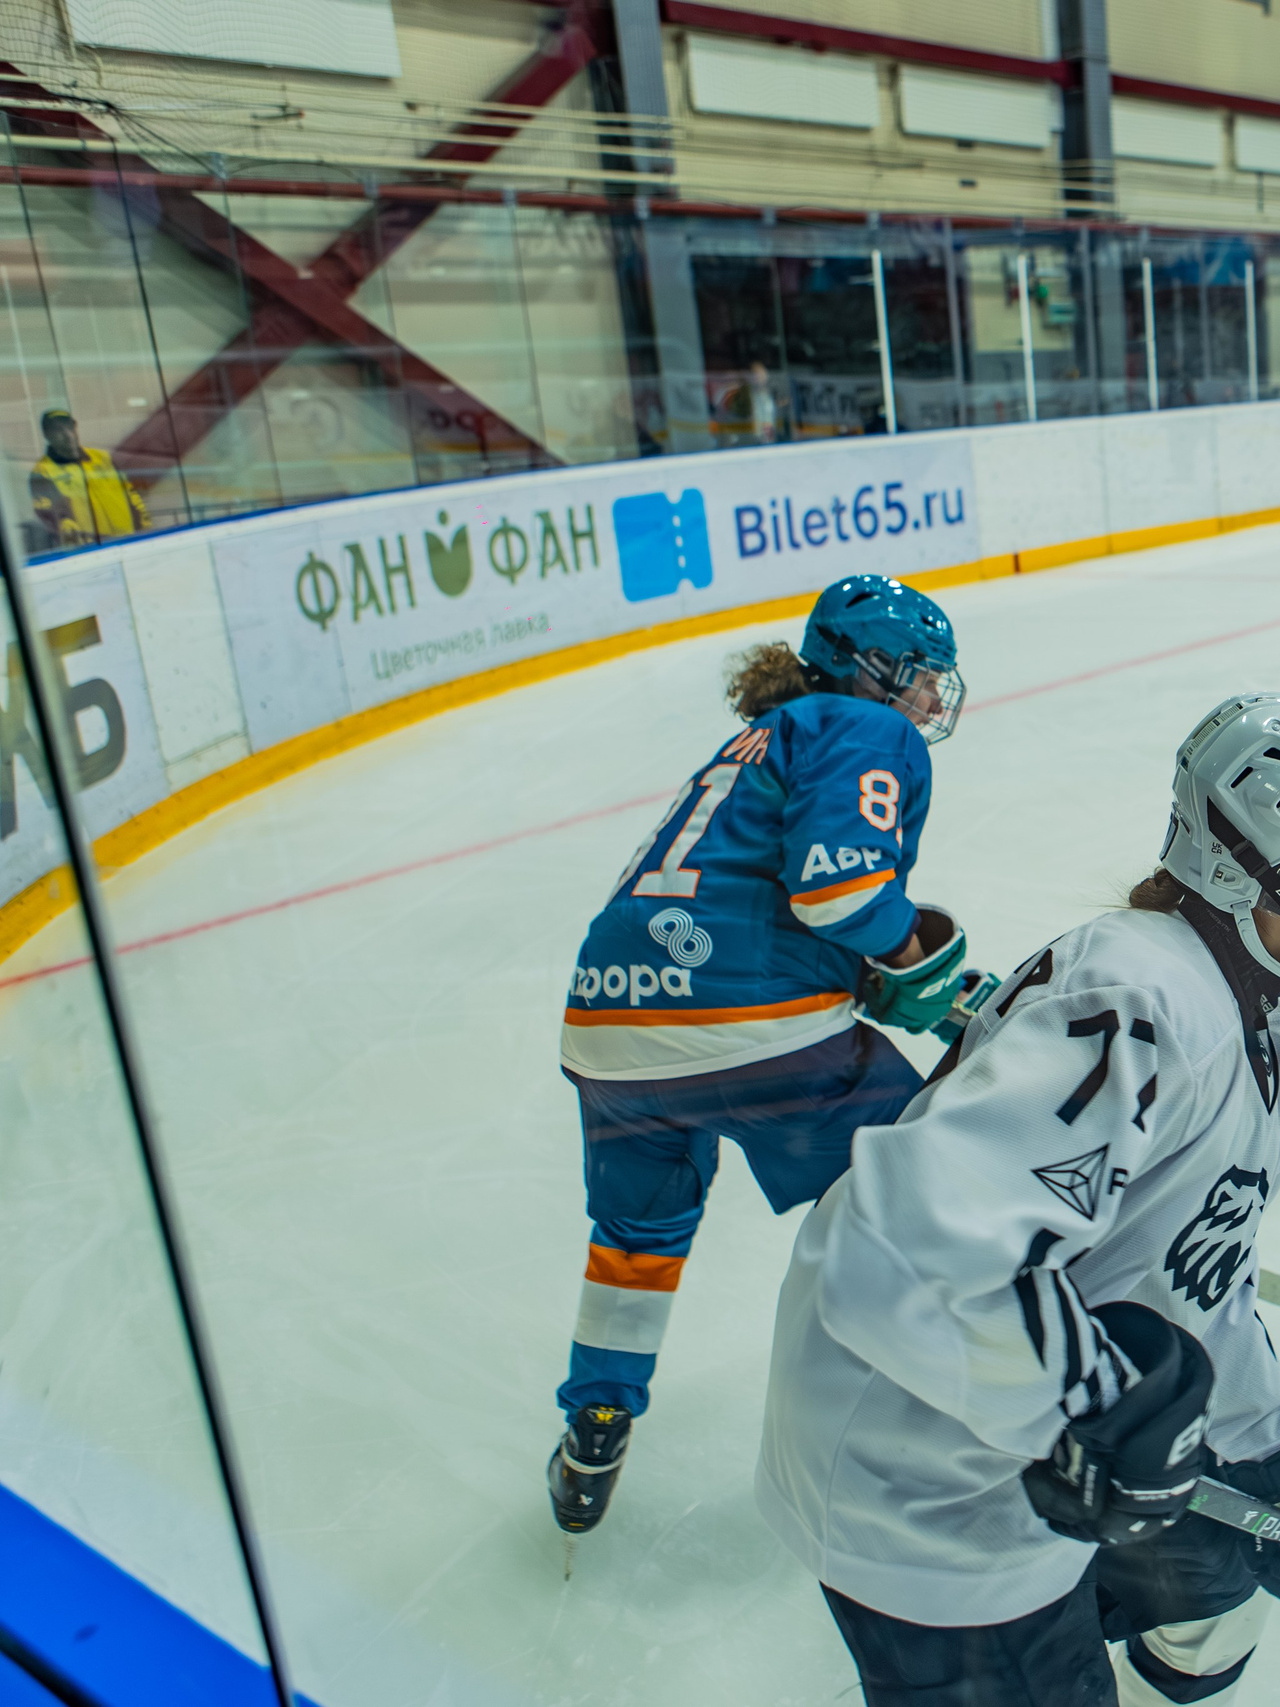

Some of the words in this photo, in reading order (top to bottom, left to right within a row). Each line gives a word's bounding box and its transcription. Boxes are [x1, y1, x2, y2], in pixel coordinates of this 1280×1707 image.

[734, 481, 965, 559] Bilet65.ru
[296, 534, 417, 633] ФАН
[489, 504, 599, 586] ФАН
[859, 769, 902, 848] 8
